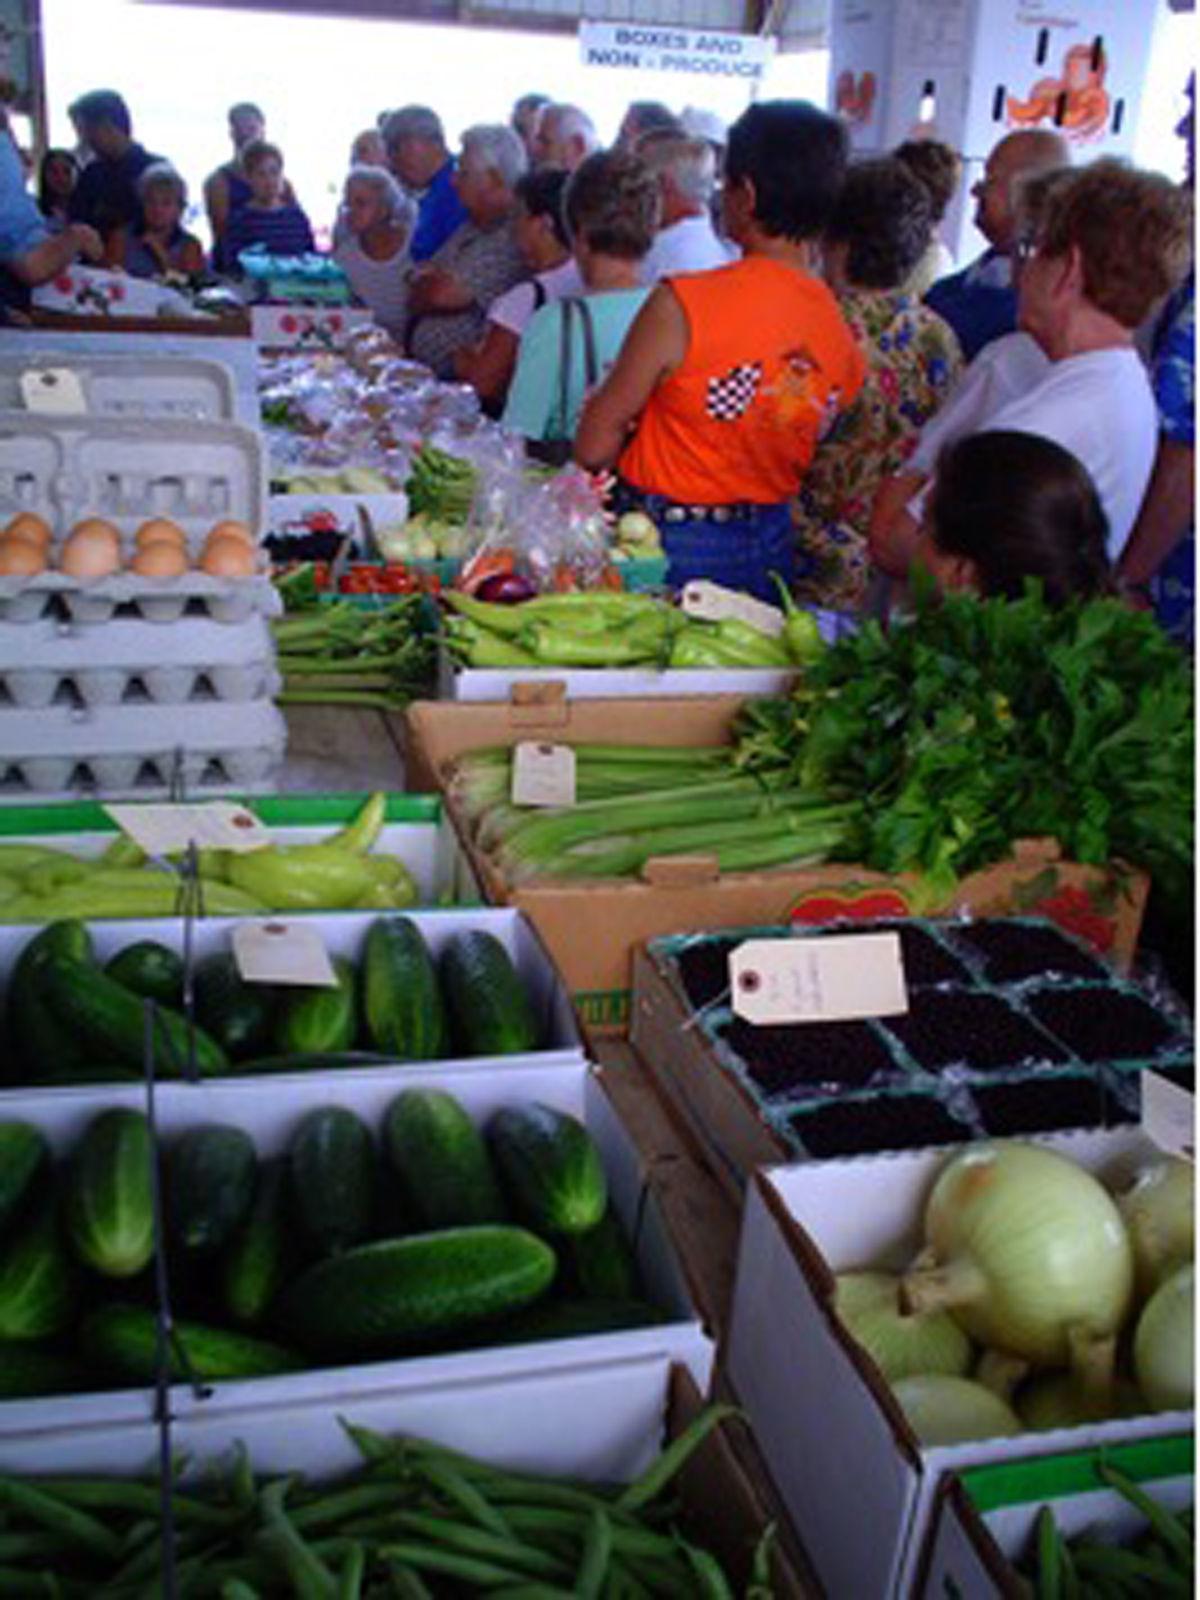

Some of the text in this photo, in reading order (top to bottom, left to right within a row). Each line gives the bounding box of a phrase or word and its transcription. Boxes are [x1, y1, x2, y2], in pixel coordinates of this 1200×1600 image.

[614, 28, 743, 55] BOXES AND
[586, 48, 640, 68] NON
